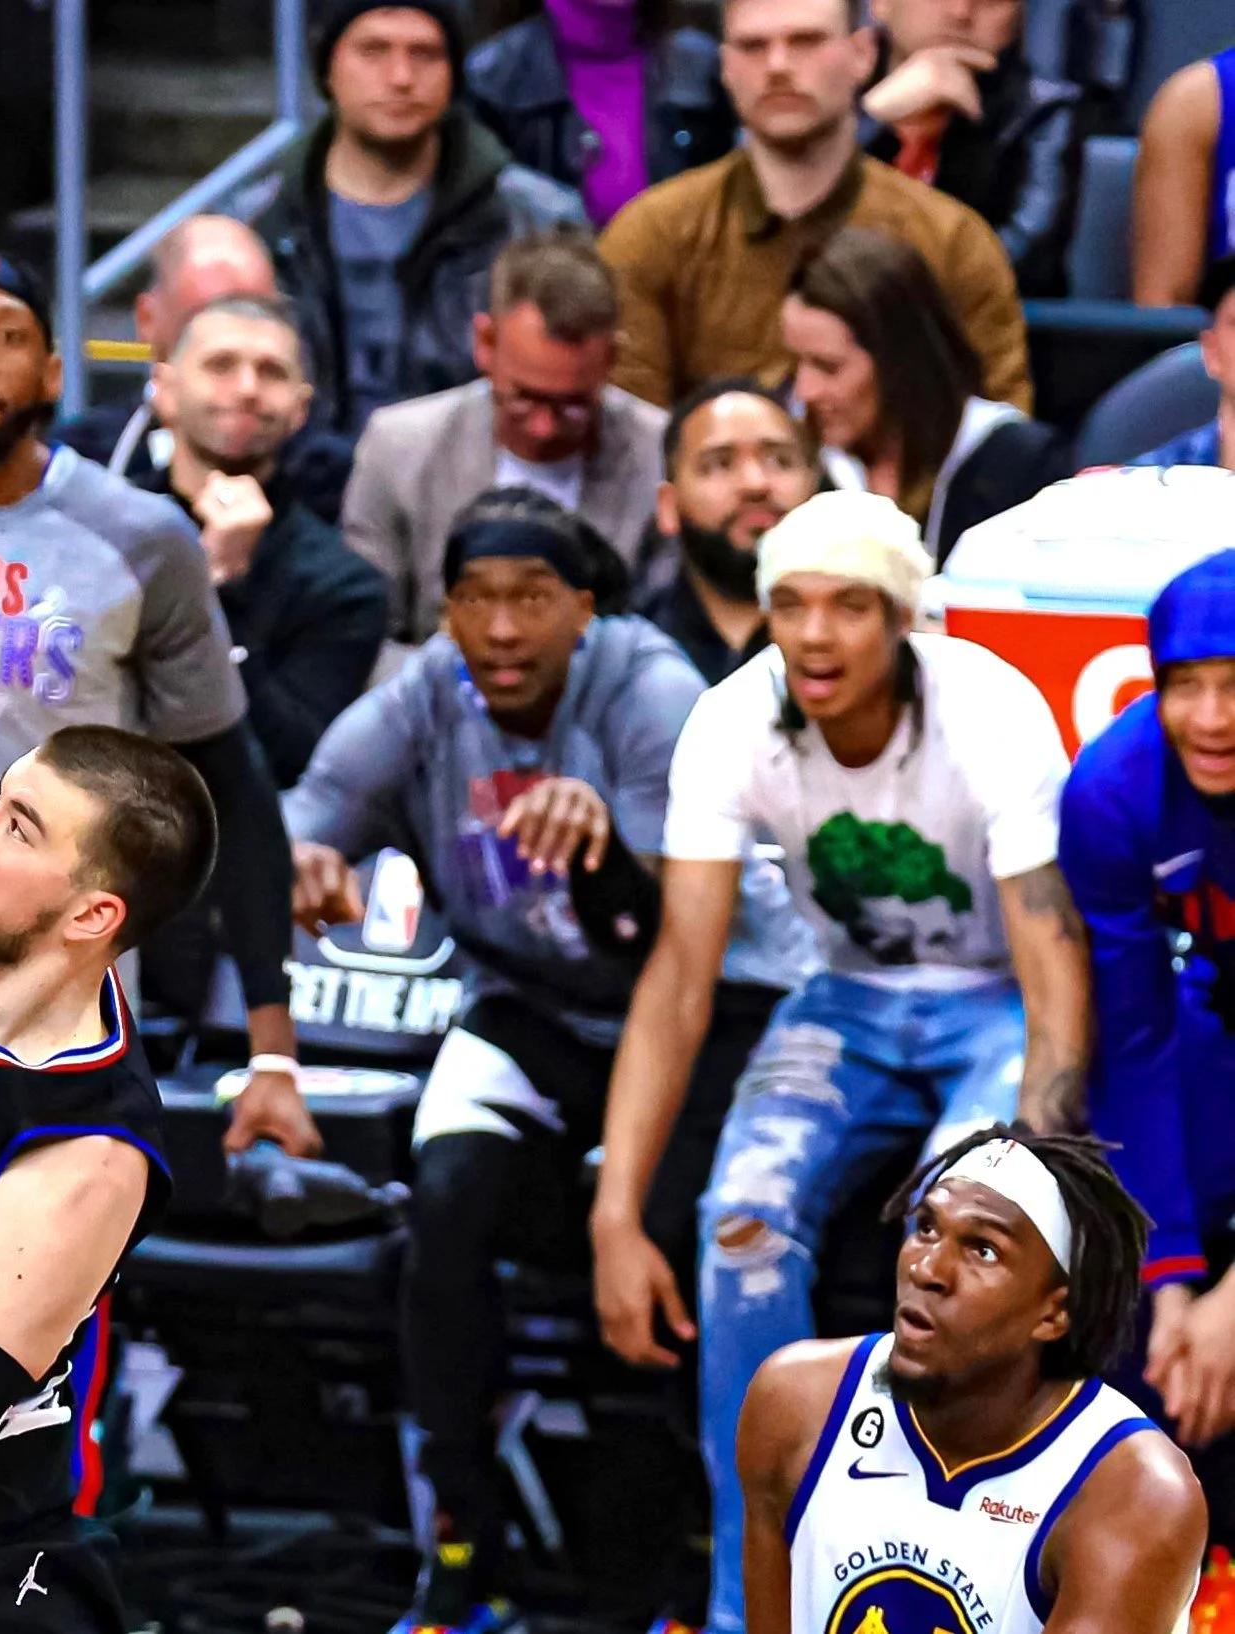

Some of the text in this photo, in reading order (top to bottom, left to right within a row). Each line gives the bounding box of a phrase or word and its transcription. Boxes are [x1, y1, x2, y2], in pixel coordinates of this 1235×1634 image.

[343, 970, 406, 1032] THE
[834, 1542, 994, 1629] GOLDEN STATE
